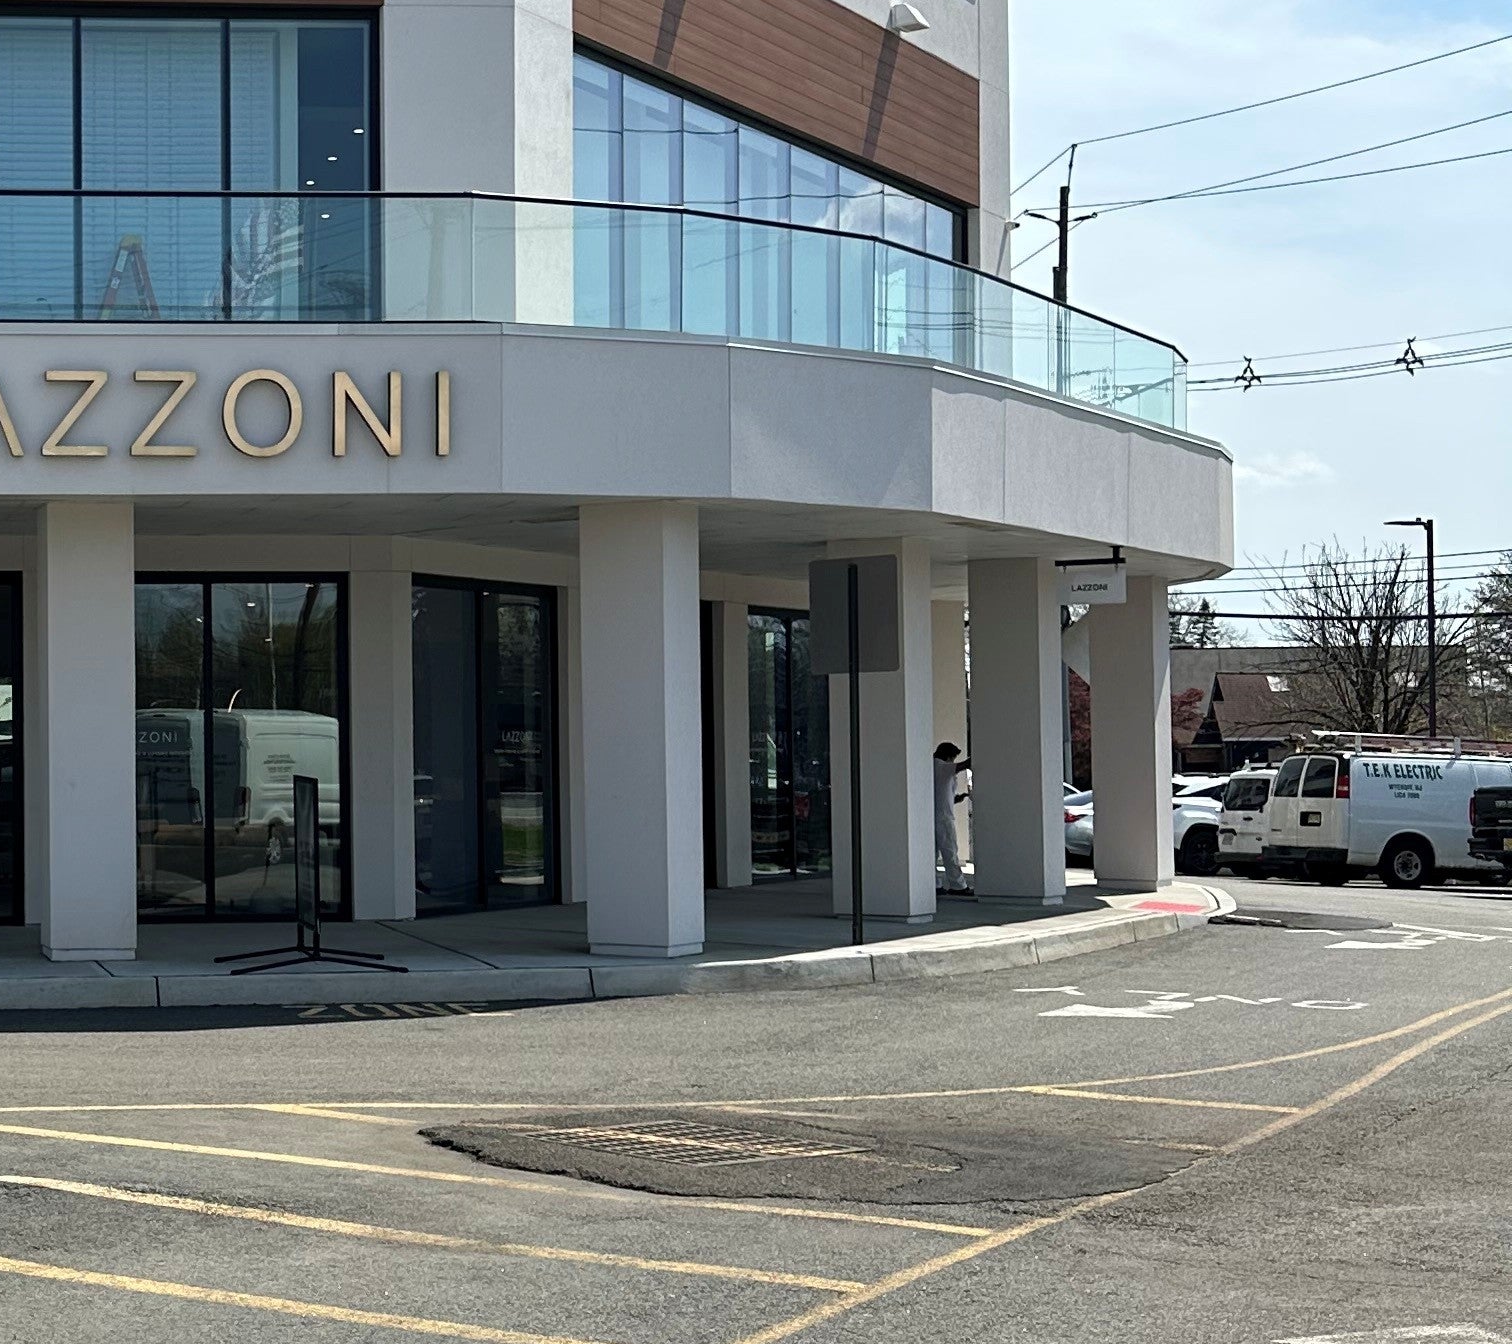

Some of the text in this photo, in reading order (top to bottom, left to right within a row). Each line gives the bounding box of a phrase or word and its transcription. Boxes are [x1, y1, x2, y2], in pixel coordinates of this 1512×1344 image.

[1071, 583, 1108, 592] LAZZONI
[1393, 763, 1443, 781] ELECTRIC
[283, 1002, 516, 1019] ZONE
